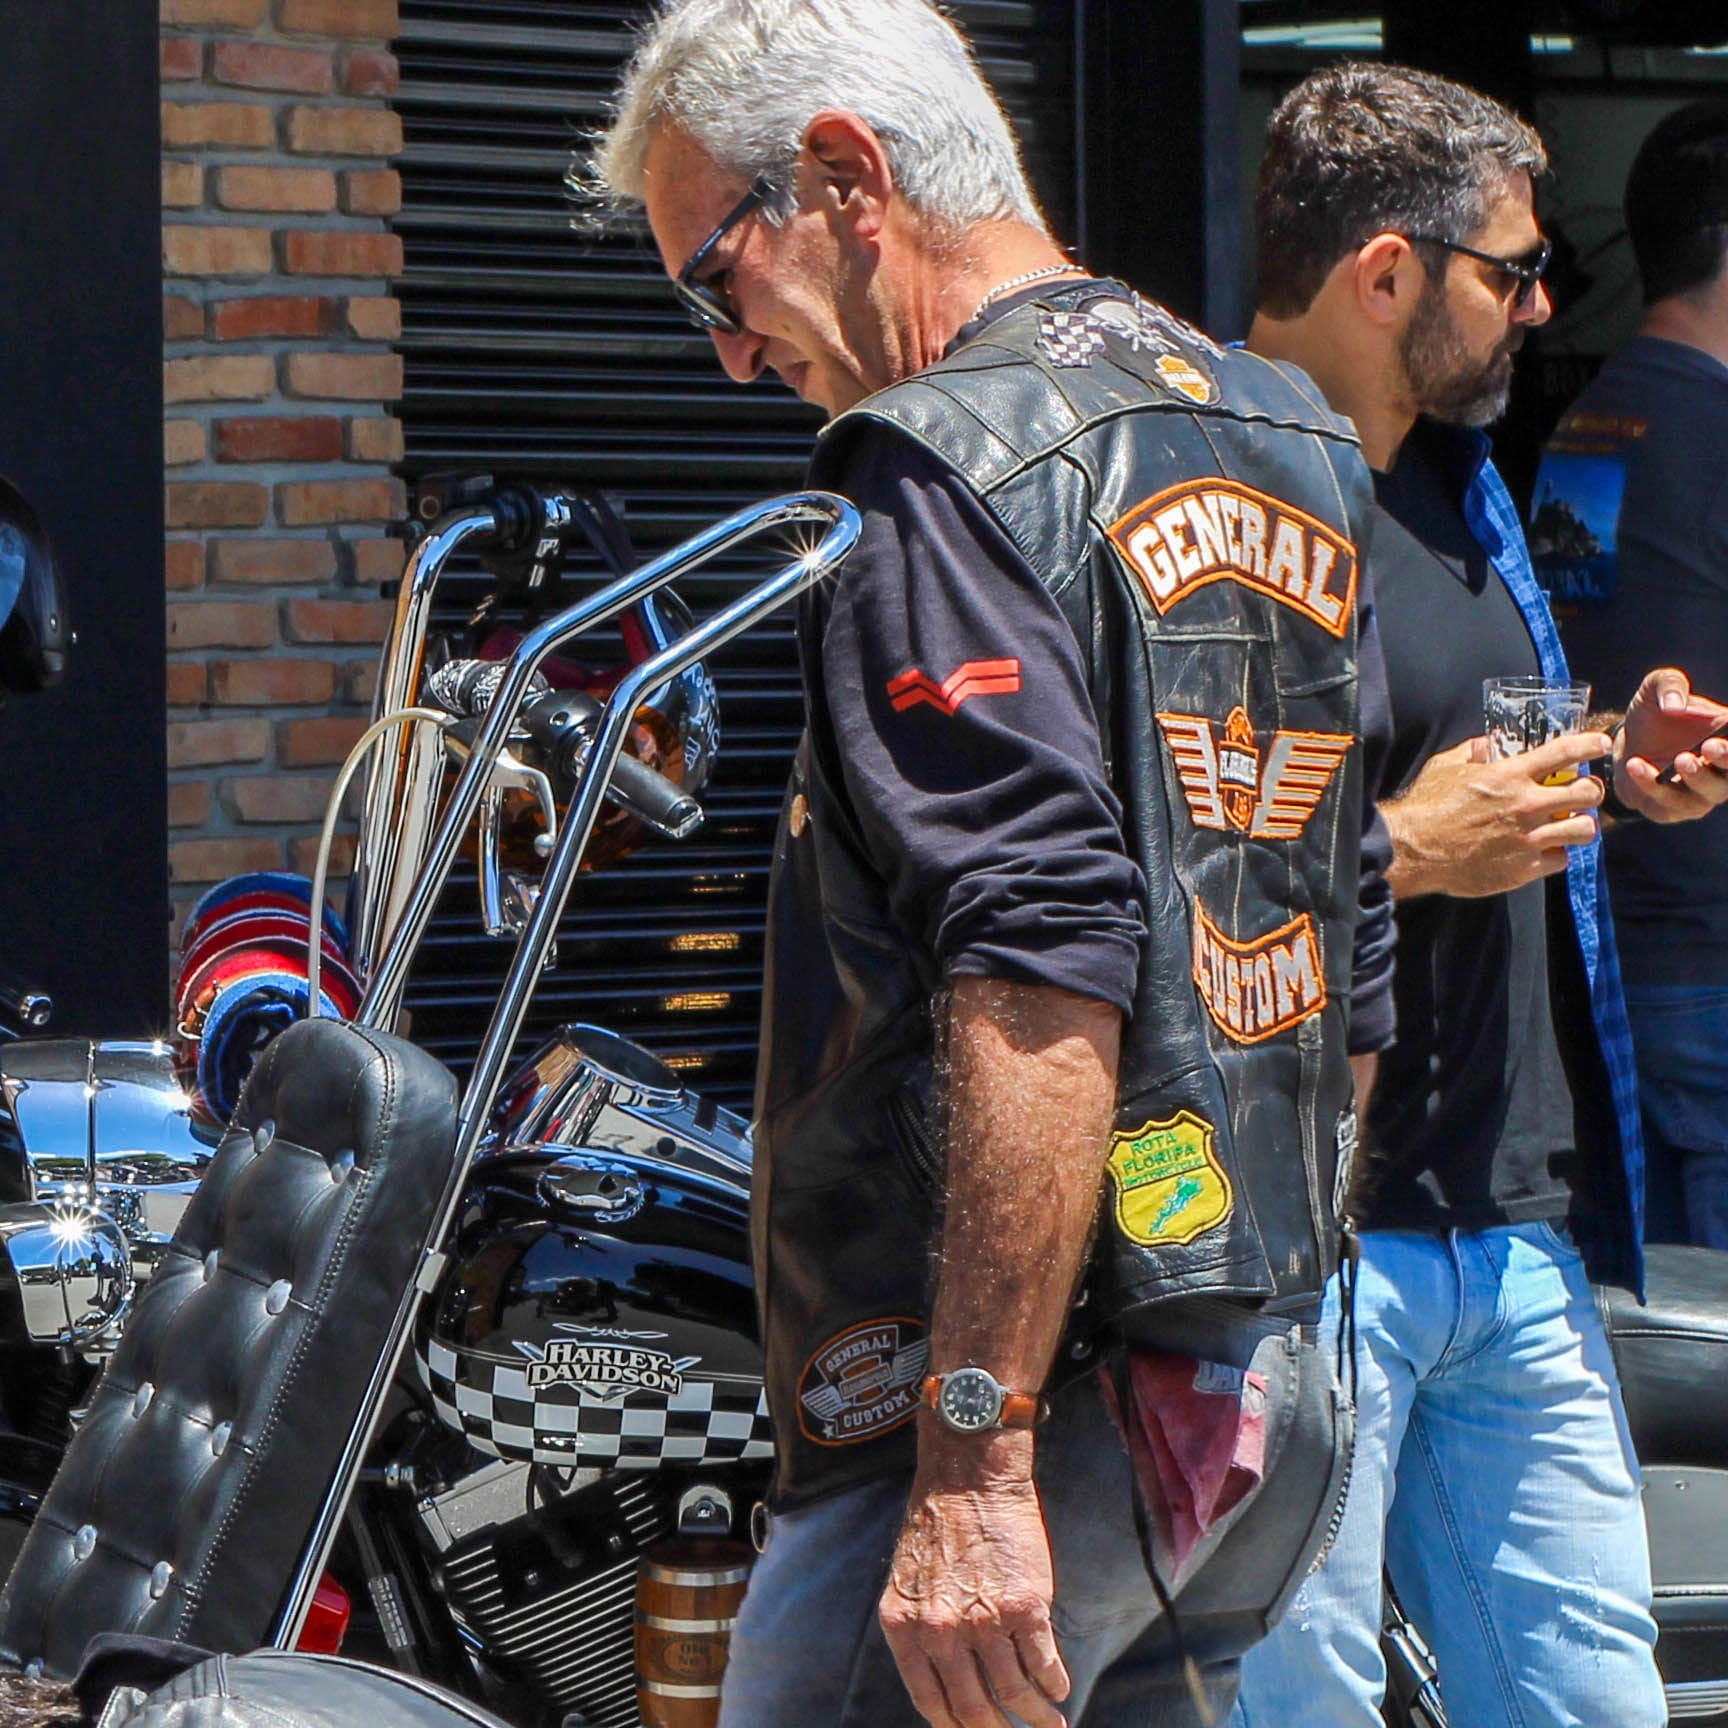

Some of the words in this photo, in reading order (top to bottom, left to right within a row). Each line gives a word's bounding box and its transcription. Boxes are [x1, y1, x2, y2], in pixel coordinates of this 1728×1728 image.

[1128, 490, 1345, 627] GENERAL
[1193, 928, 1321, 1035] CUSTOM
[1123, 1143, 1196, 1177] FLORIPA
[1131, 1131, 1177, 1154] ROTA
[548, 1343, 672, 1371] HARLEY-
[825, 1335, 891, 1372] GENERAL
[531, 1364, 678, 1391] DAVIDSON
[843, 1390, 910, 1428] CUSTOM
